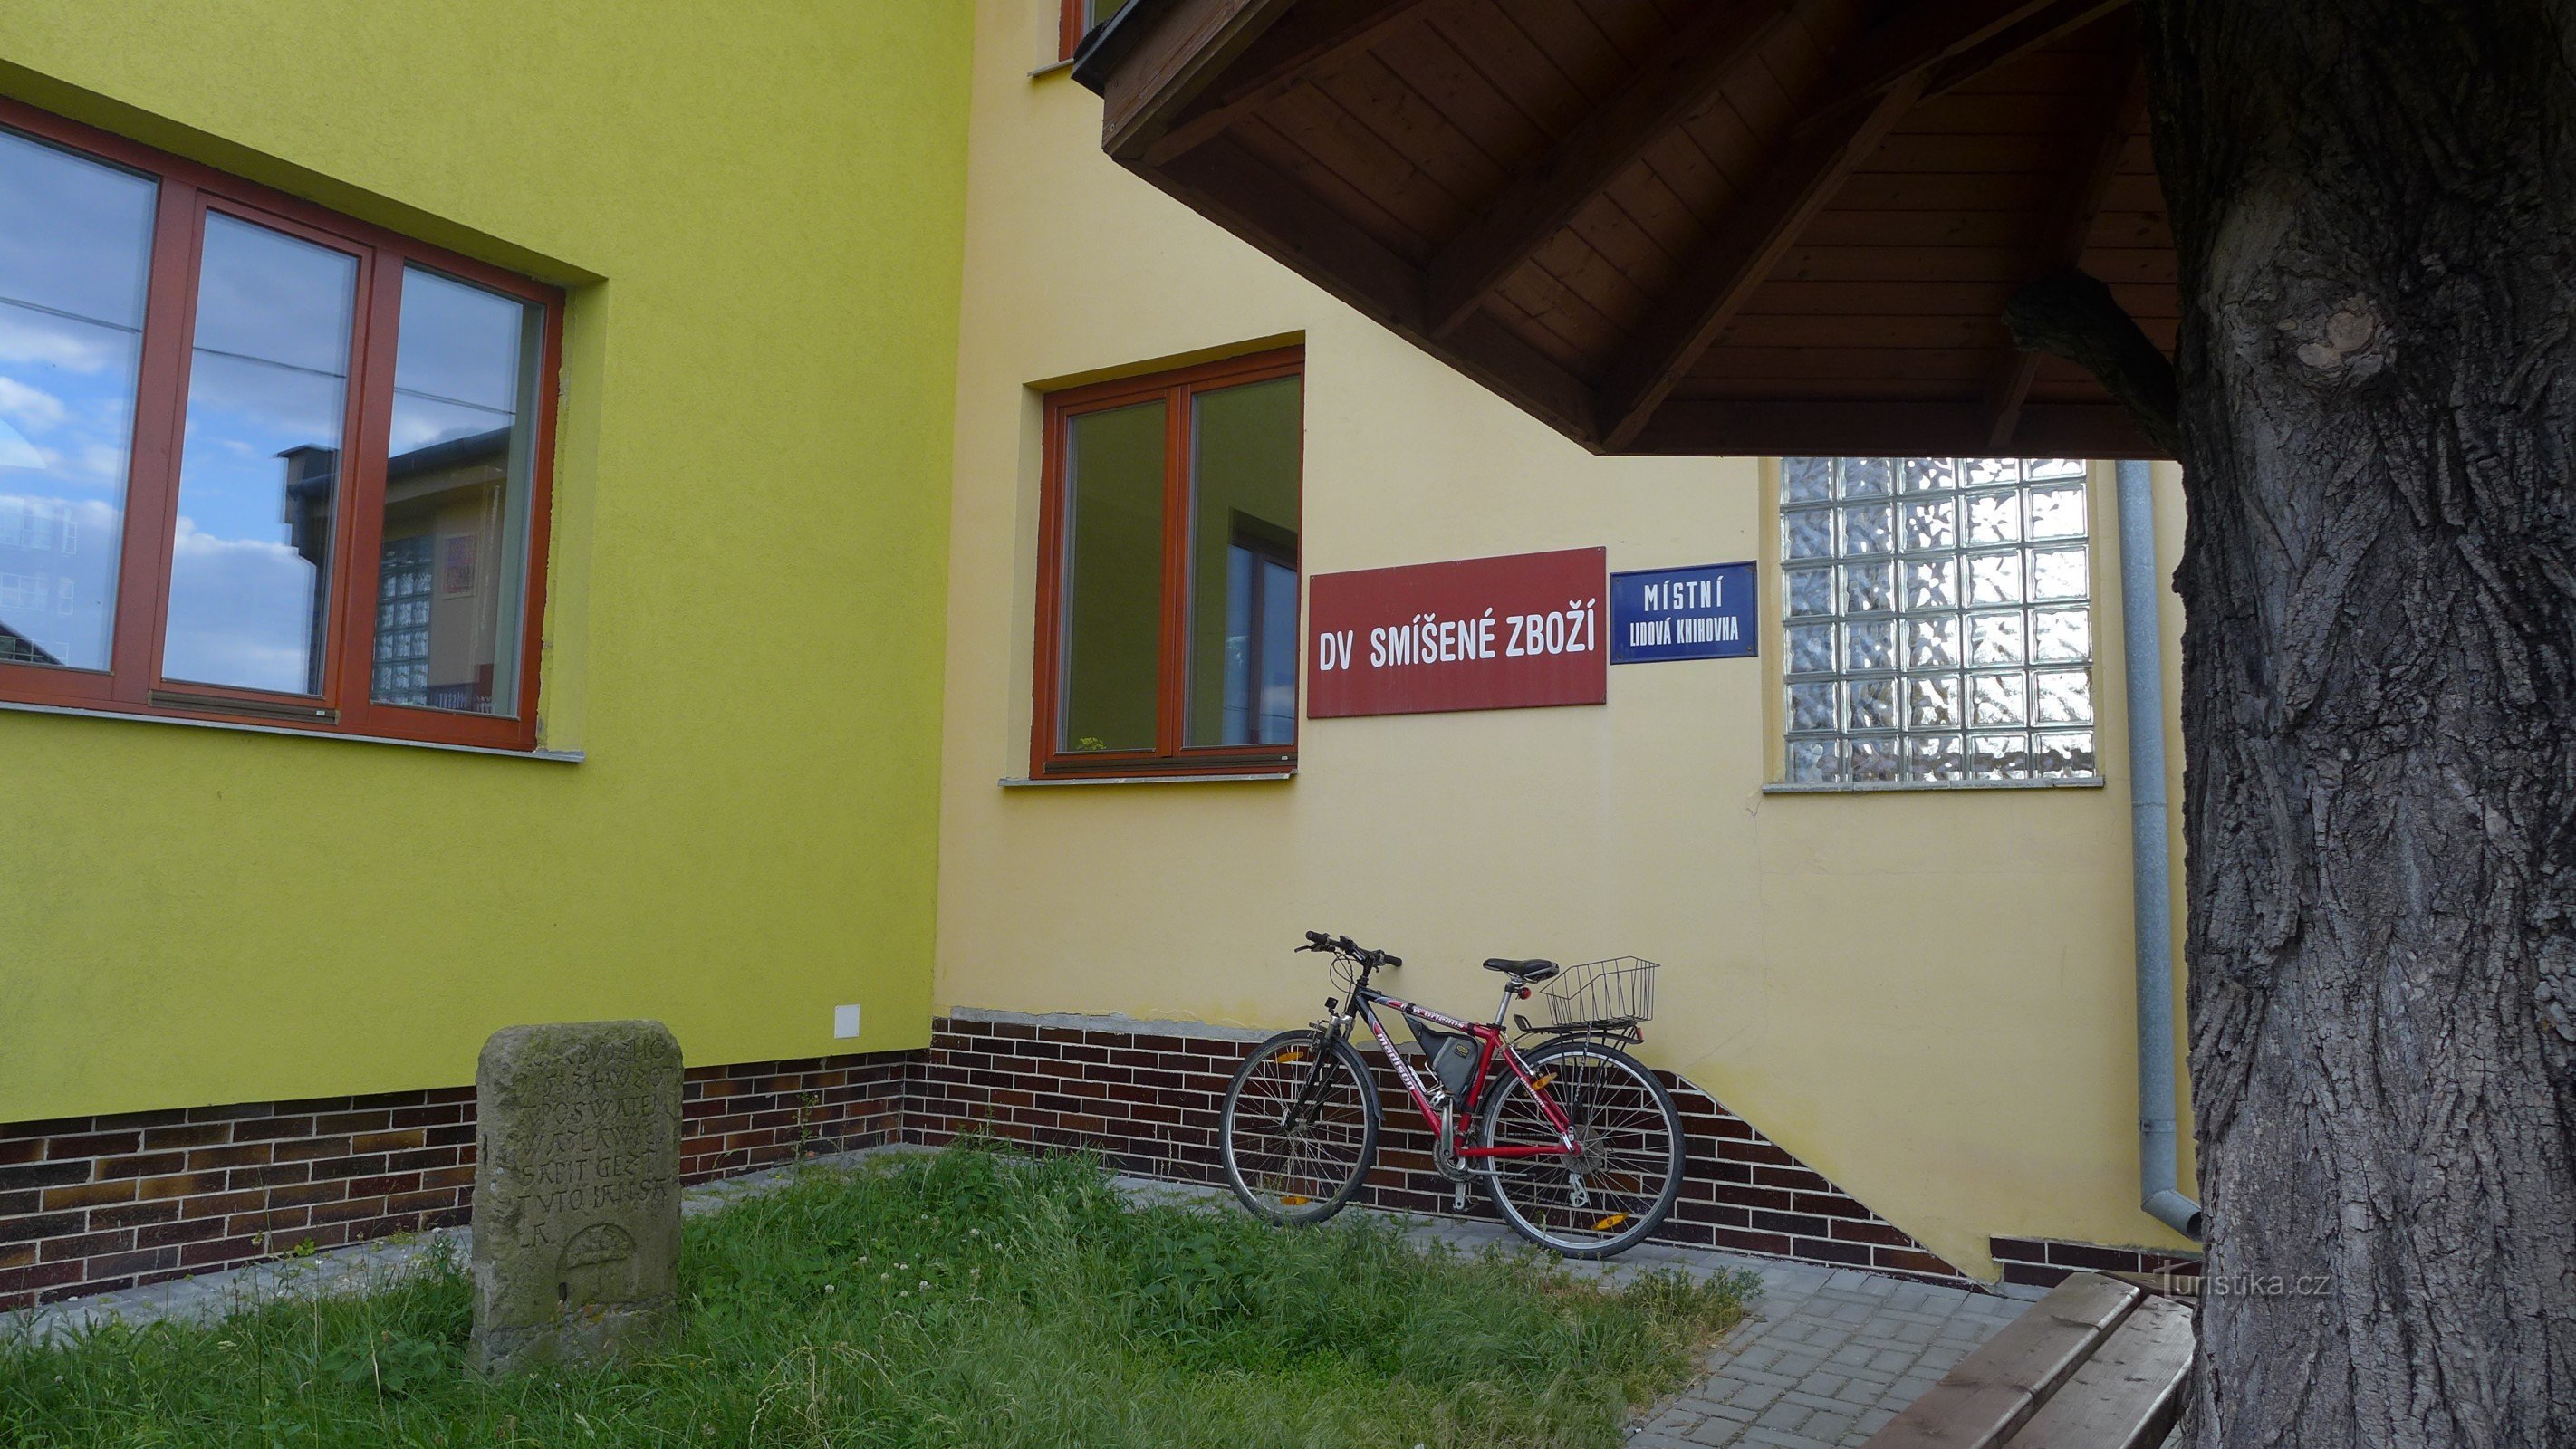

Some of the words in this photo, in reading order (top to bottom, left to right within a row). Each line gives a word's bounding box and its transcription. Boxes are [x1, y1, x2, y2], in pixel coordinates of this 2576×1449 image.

[1644, 575, 1724, 611] MÍSTNÍ
[1320, 630, 1354, 671] DV
[1370, 607, 1495, 668] SMÍŠENÉ
[1506, 598, 1596, 657] ZBOŽÍ
[1630, 617, 1672, 647] LIDOVÁ
[1677, 616, 1739, 644] KNIHOVNA
[1376, 1032, 1415, 1090] madison
